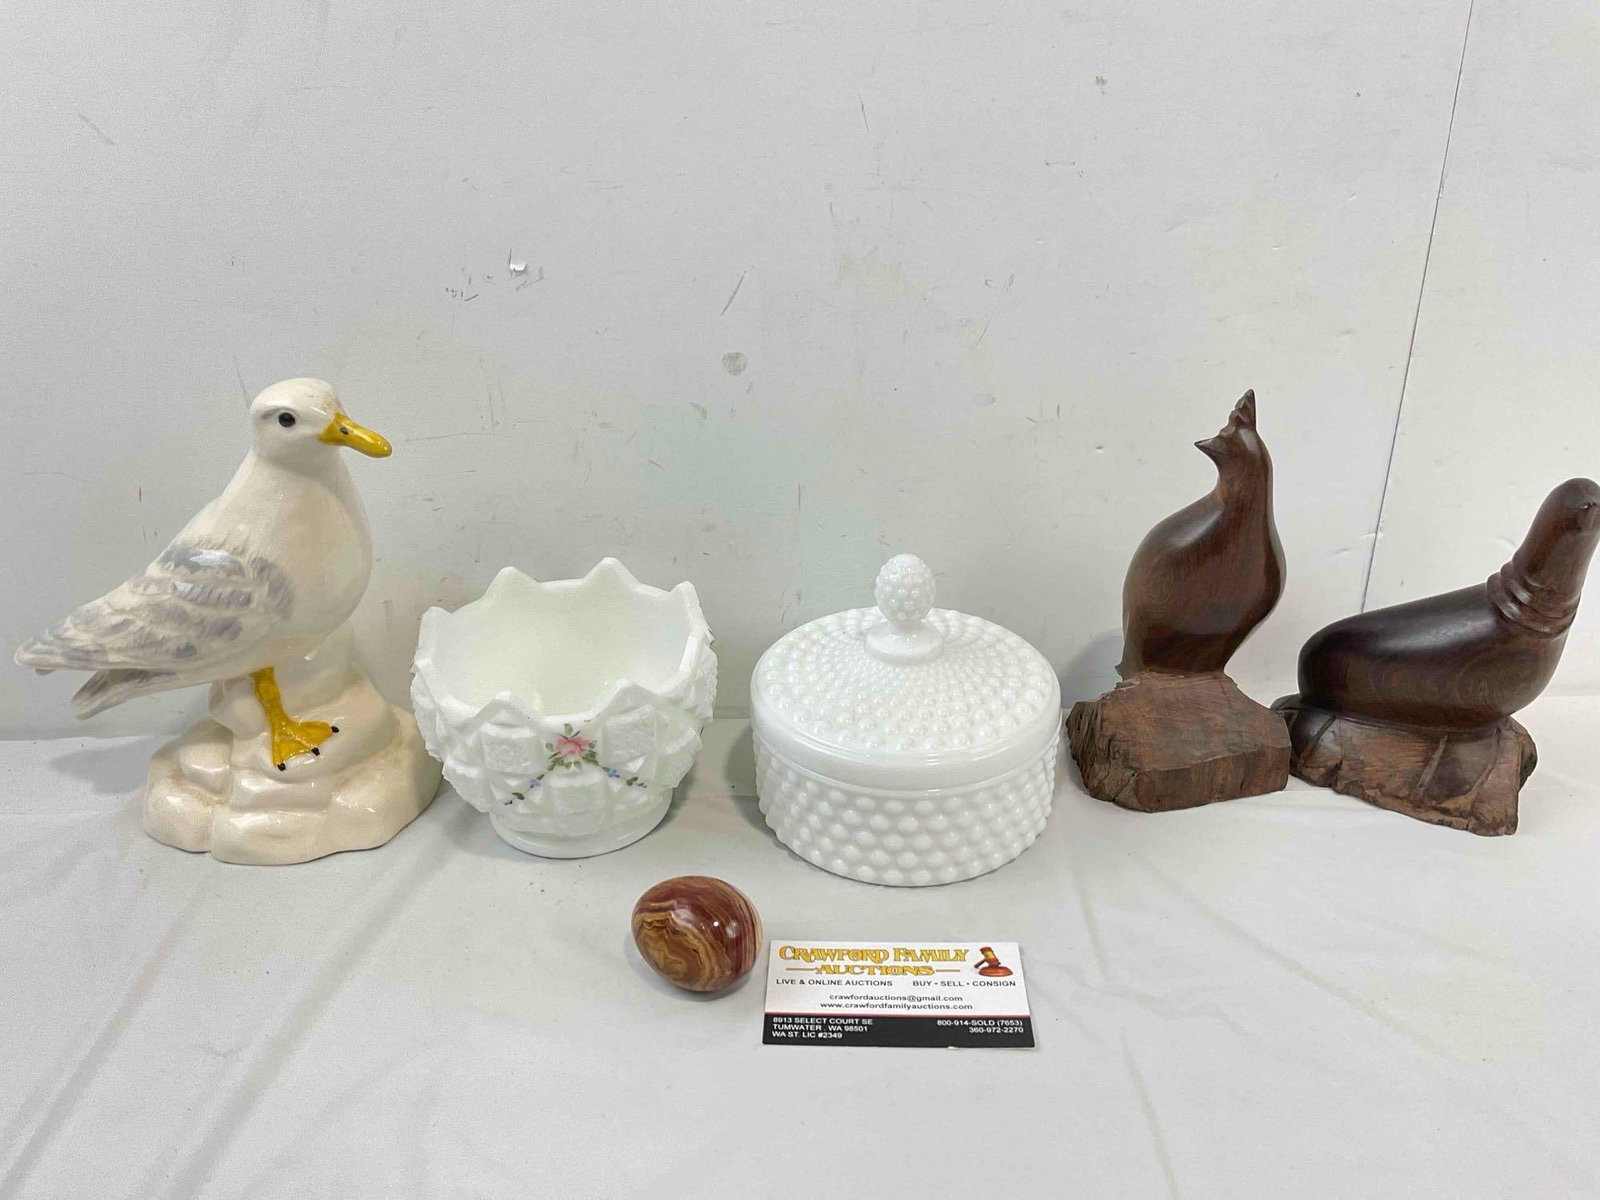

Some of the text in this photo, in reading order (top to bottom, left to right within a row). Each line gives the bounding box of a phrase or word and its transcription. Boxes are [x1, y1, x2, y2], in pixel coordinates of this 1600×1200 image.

[815, 964, 935, 976] AUCTIONS
[829, 994, 963, 1002] crawfordauctions@gmail.com
[820, 1002, 973, 1010] www.crawfordfamilyauctions.com
